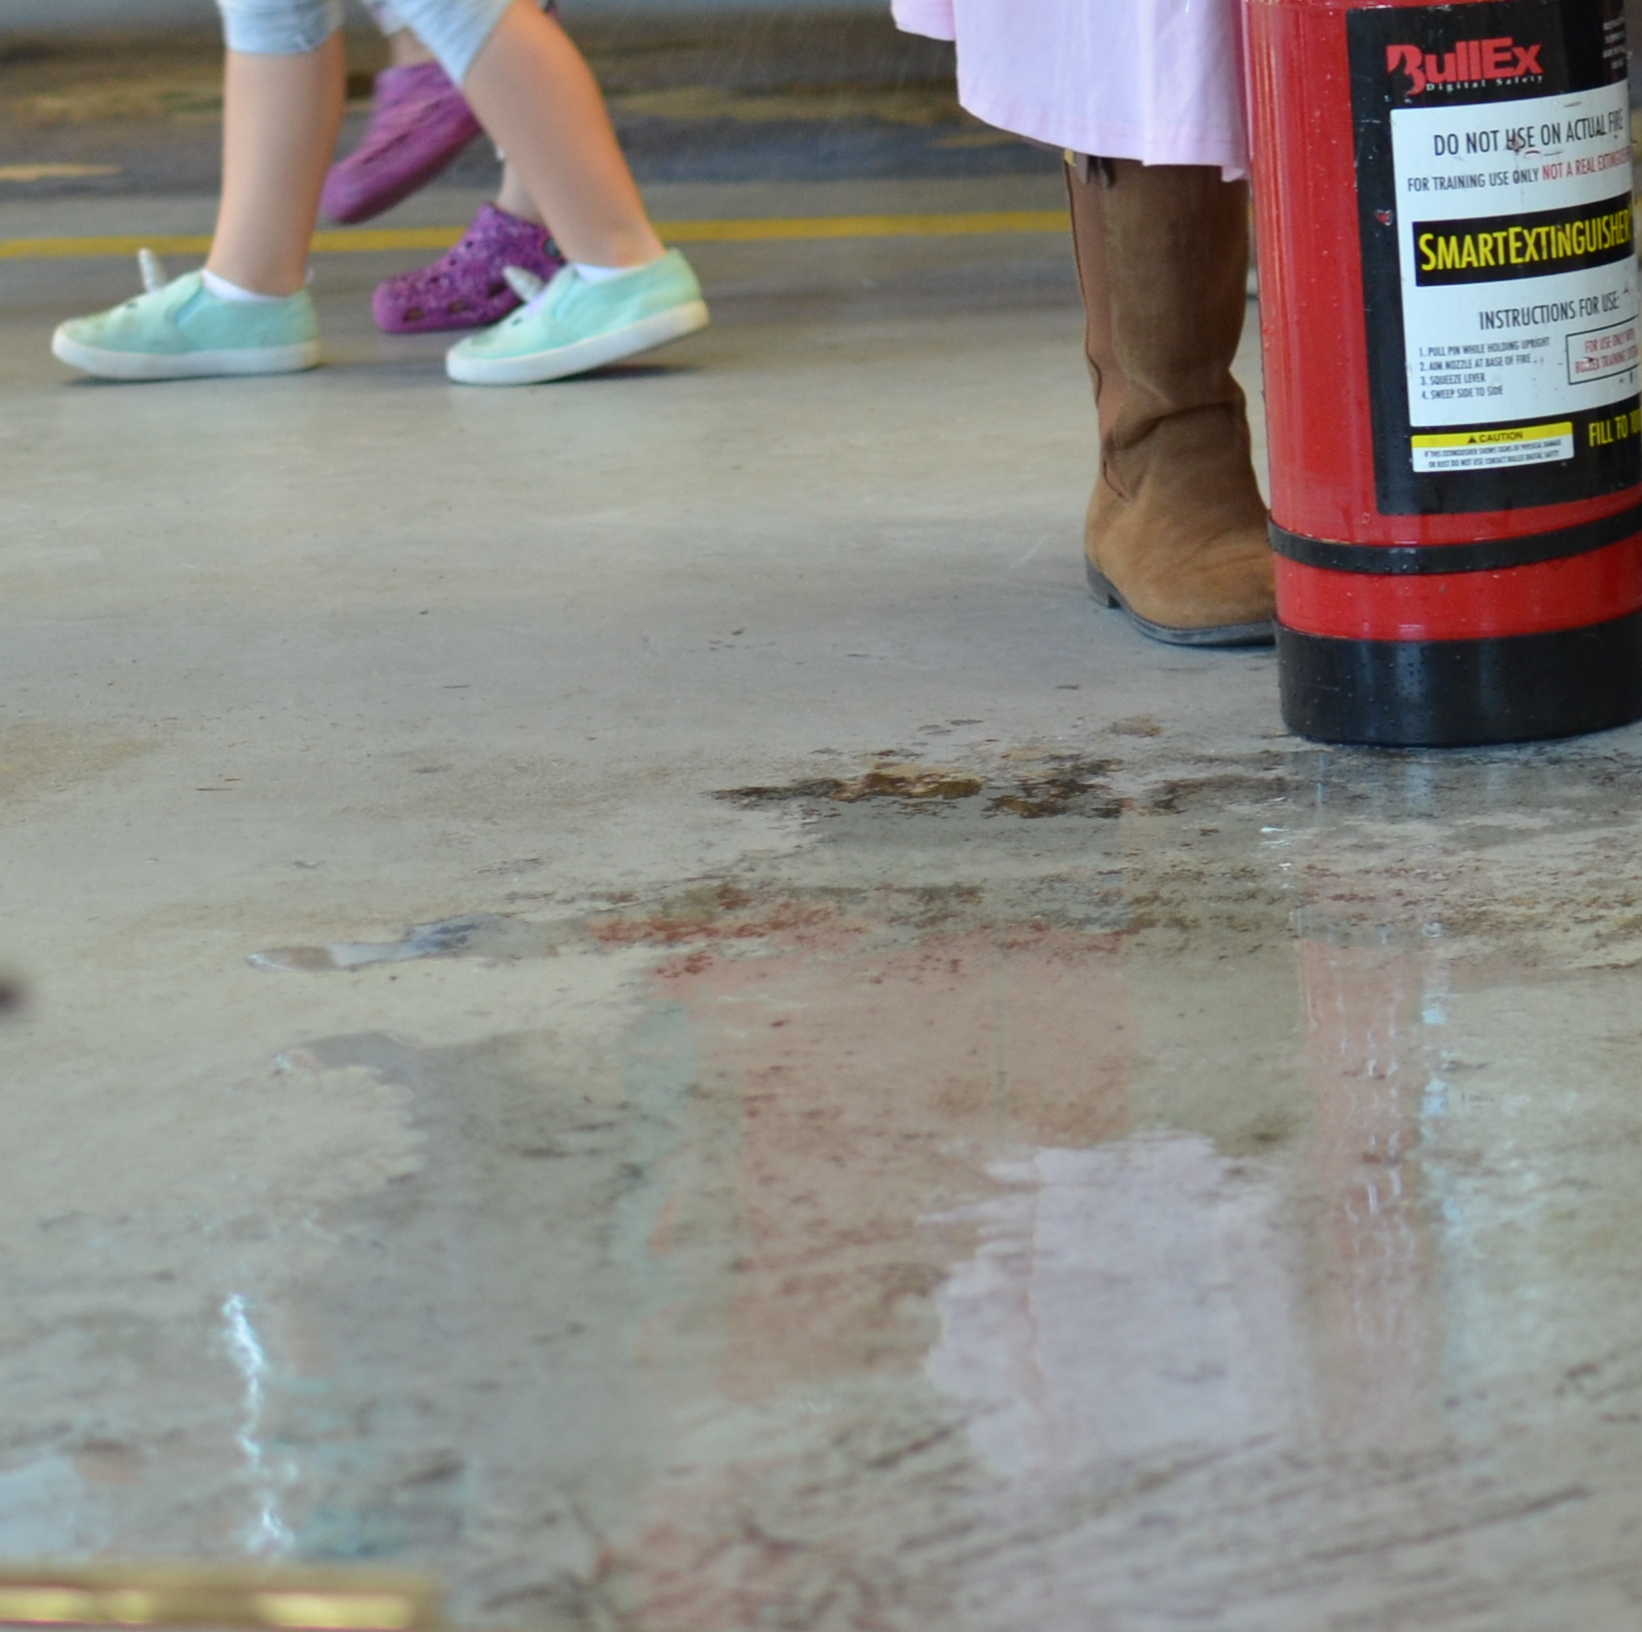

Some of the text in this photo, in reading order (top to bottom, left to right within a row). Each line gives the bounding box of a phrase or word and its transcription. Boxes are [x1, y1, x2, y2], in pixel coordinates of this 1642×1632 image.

[1426, 74, 1543, 94] Digital Safety
[1433, 134, 1459, 156] DO
[1466, 129, 1500, 154] NOT
[1506, 125, 1535, 151] USE
[1540, 122, 1561, 146] ON
[1566, 114, 1607, 143] ACTUAL
[1408, 176, 1430, 192] FOR
[1434, 171, 1486, 191] TRAINING
[1489, 170, 1510, 187] USE
[1512, 166, 1540, 185] ONLY
[1542, 162, 1563, 181] NOT
[1565, 161, 1574, 177] A
[1575, 157, 1597, 176] REAL
[1479, 299, 1577, 331] INSTRUCTIONS
[1579, 296, 1601, 318] FOR
[1428, 346, 1447, 357] PULL
[1447, 345, 1461, 356] PIN
[1462, 344, 1486, 355] WHILE
[1487, 341, 1520, 353] HOLDING
[1520, 336, 1550, 350] UPRIGHT
[1429, 361, 1443, 371] AIM
[1445, 359, 1473, 370] NOZZLE
[1474, 358, 1484, 368] AT
[1485, 356, 1504, 368] BASE
[1504, 355, 1515, 366] OF
[1516, 353, 1531, 364] FIRE
[1429, 374, 1462, 385] SQUEEZE
[1463, 372, 1486, 384] LEVER
[1430, 389, 1455, 400] SWEEP
[1456, 388, 1473, 399] SIDE
[1475, 387, 1486, 397] TO
[1486, 385, 1504, 396] SIDE
[1478, 431, 1524, 443] CAUTION
[1588, 420, 1614, 447] FILL
[1614, 414, 1629, 440] TO
